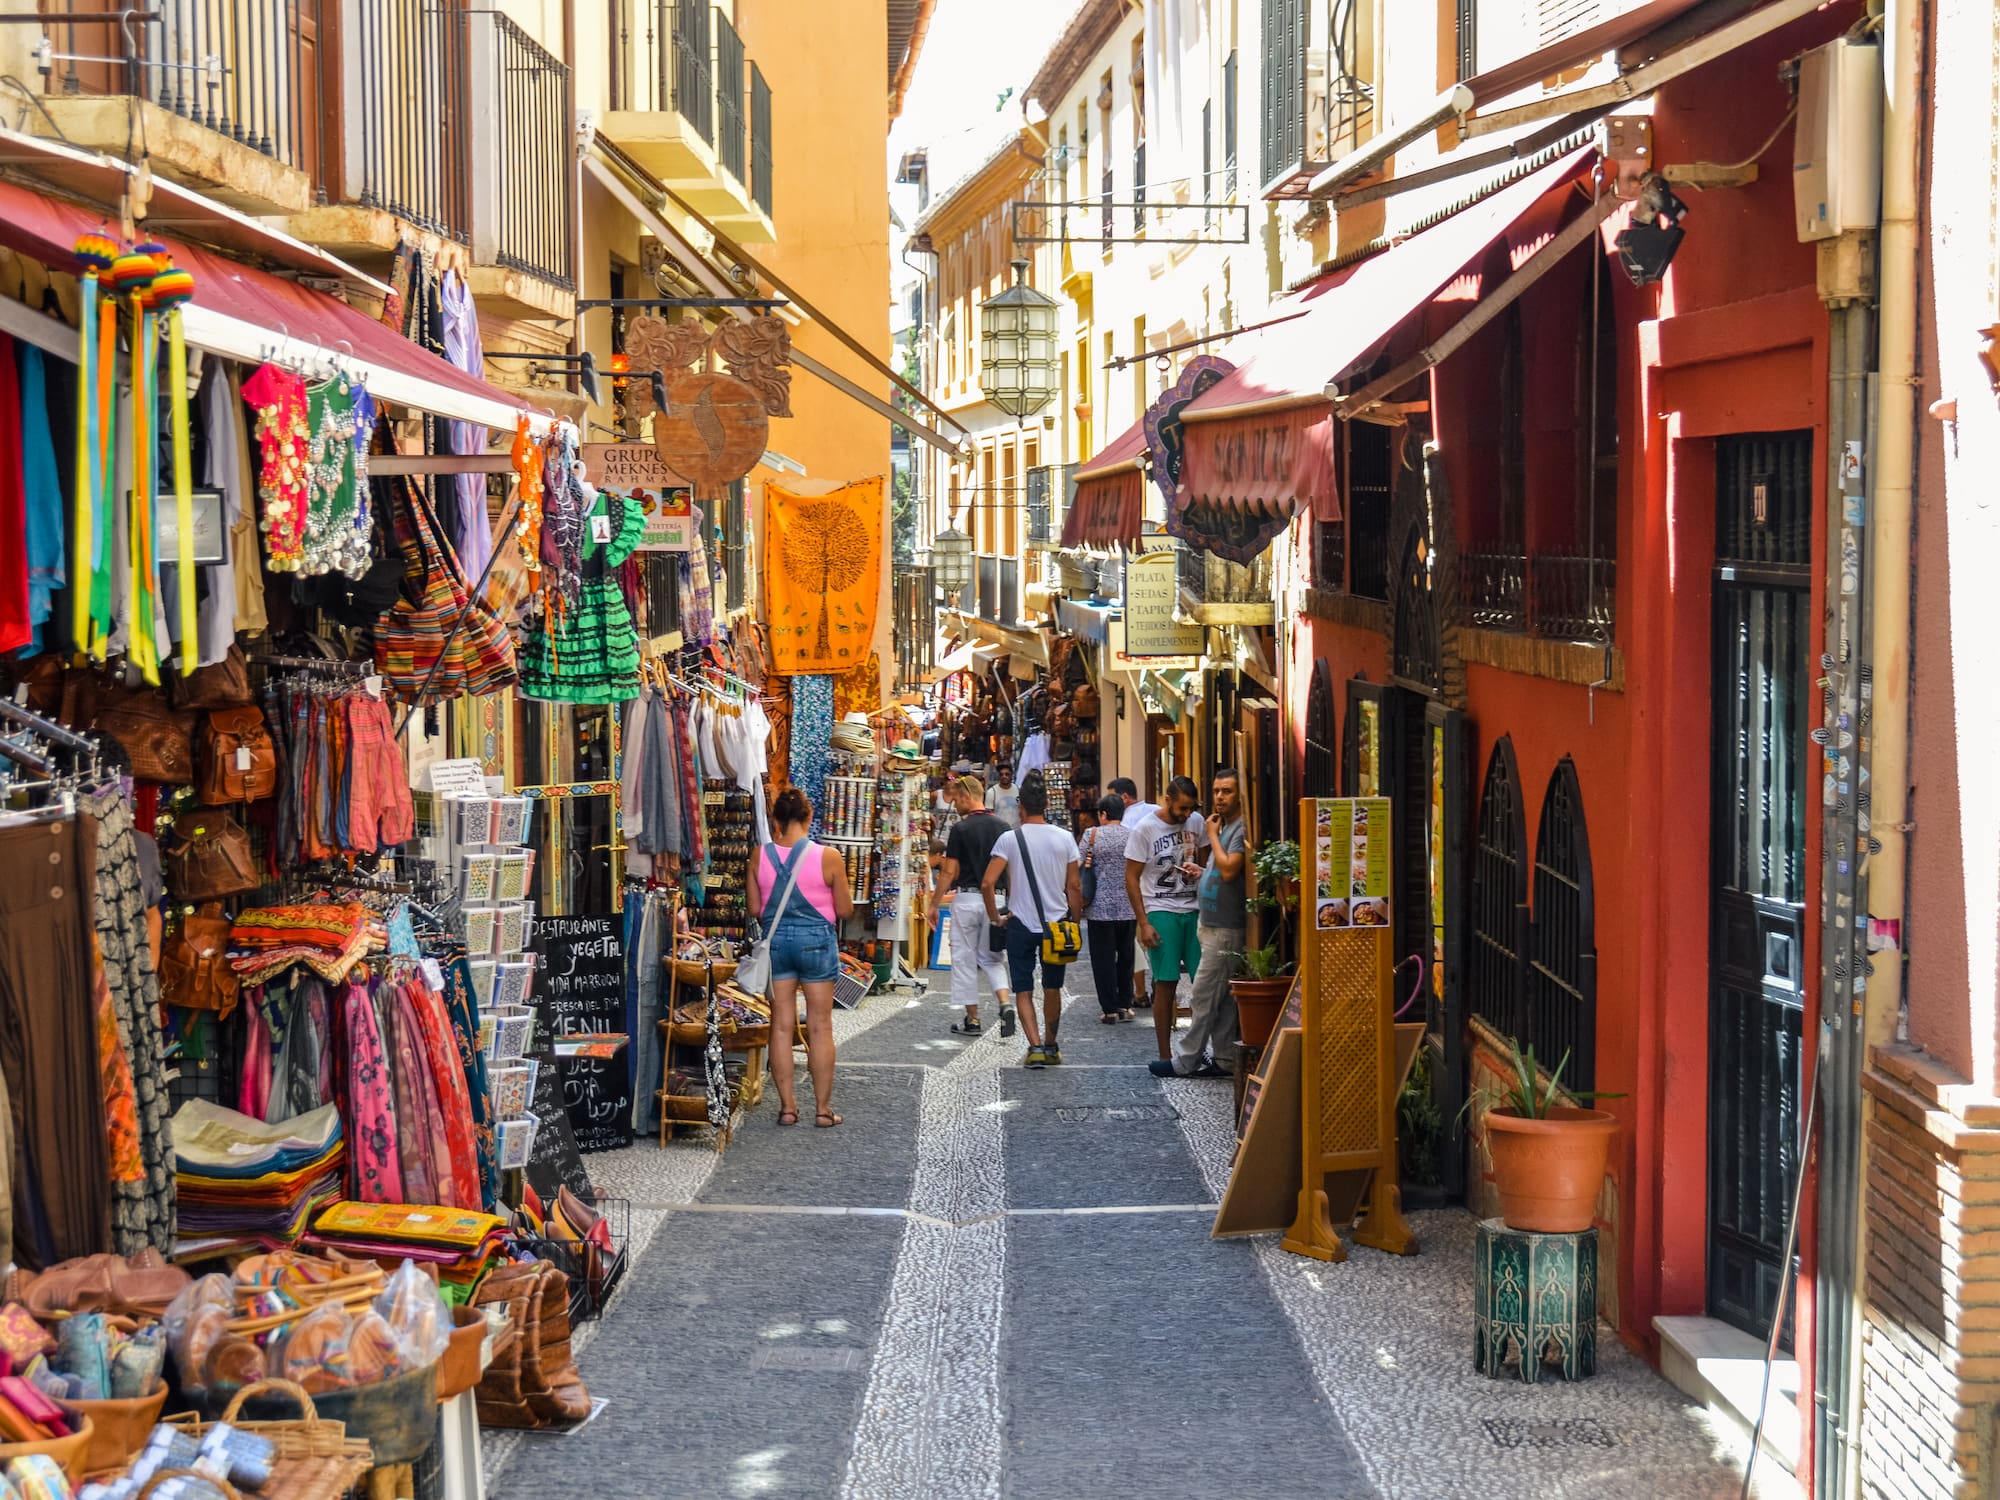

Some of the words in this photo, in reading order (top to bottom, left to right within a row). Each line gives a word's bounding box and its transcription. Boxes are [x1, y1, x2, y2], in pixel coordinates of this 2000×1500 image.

[604, 449, 663, 463] GRUPO
[605, 463, 668, 475] MEKNES
[605, 475, 668, 484] RAHMA
[641, 531, 683, 546] egetal
[1135, 573, 1166, 583] PLATA
[1135, 589, 1168, 599] SEDAS
[1136, 621, 1166, 631] TEJIDOS
[1135, 636, 1199, 647] COMPLEMENTOS
[569, 934, 623, 958] VEGETAL
[576, 1136, 627, 1150] WELCOME
